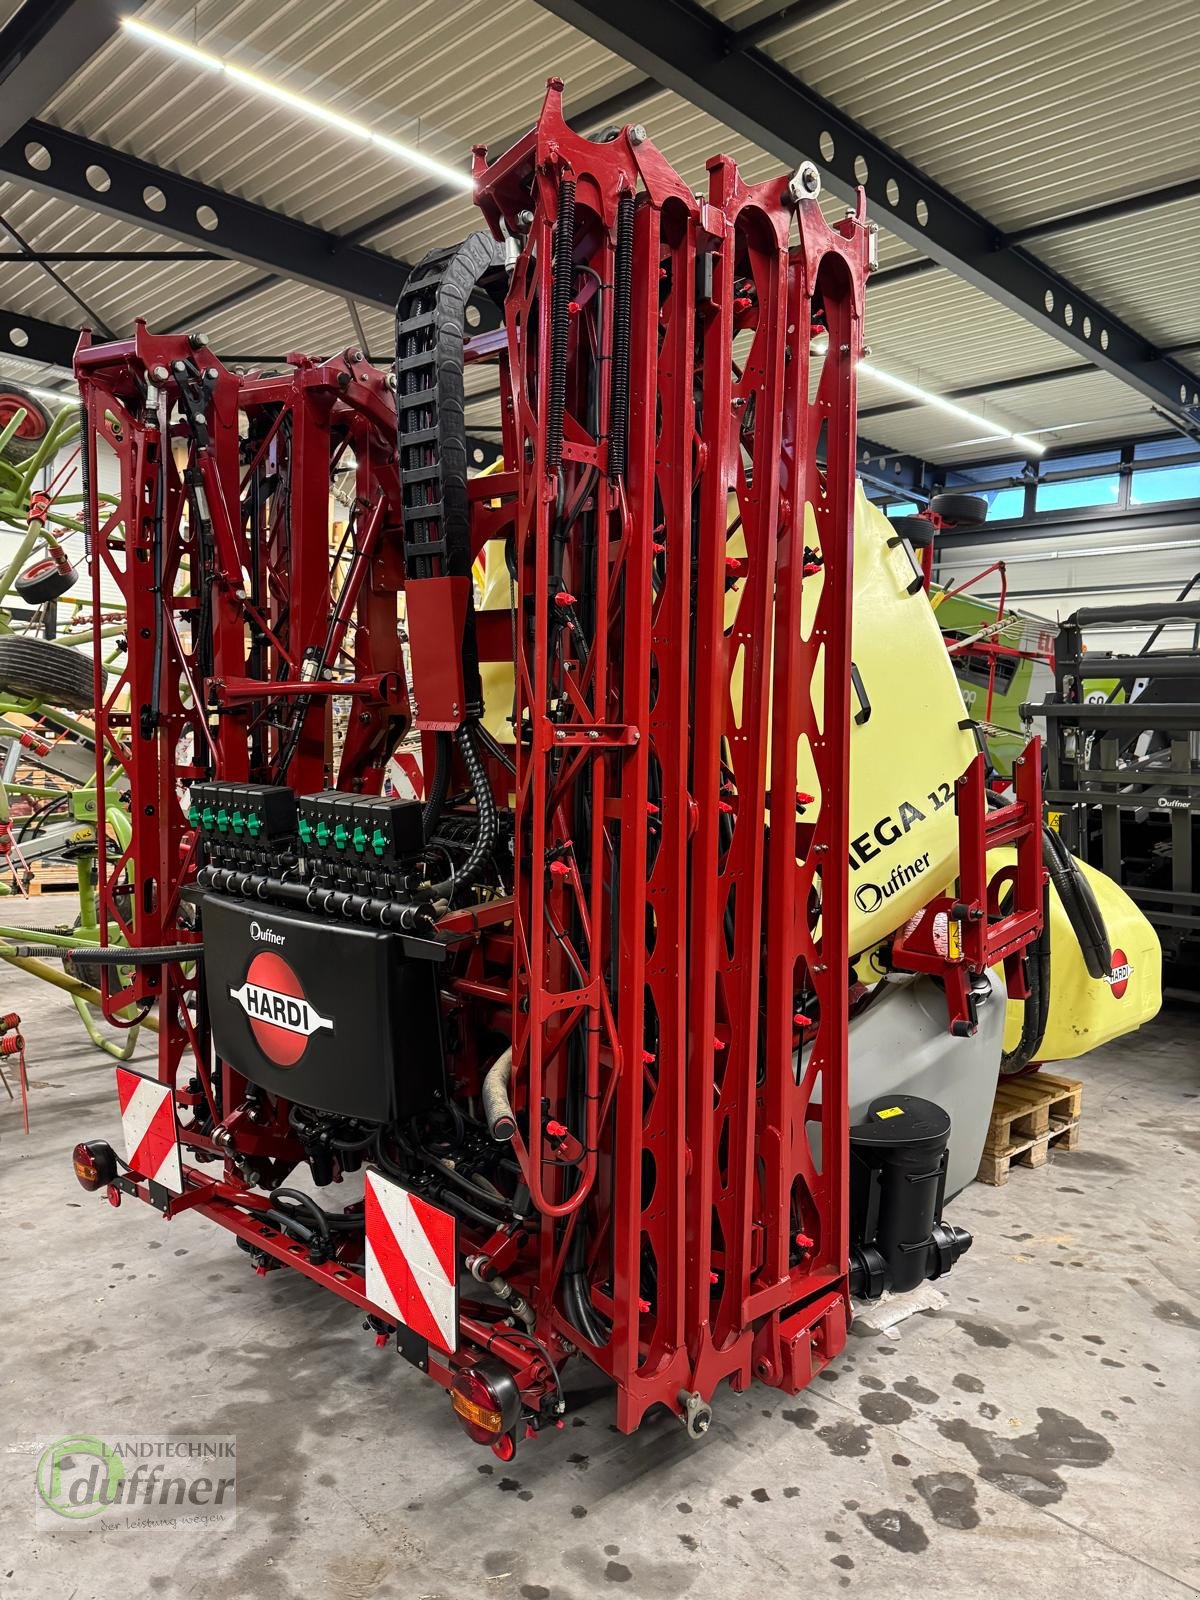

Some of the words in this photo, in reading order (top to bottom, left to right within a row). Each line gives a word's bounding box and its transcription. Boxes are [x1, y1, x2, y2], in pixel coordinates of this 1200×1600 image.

[927, 782, 956, 811] 12
[1157, 797, 1191, 808] Duffner
[854, 852, 931, 913] Duffner
[250, 920, 286, 946] Duffner
[1109, 966, 1129, 982] HARDI
[246, 987, 310, 1031] HARDI
